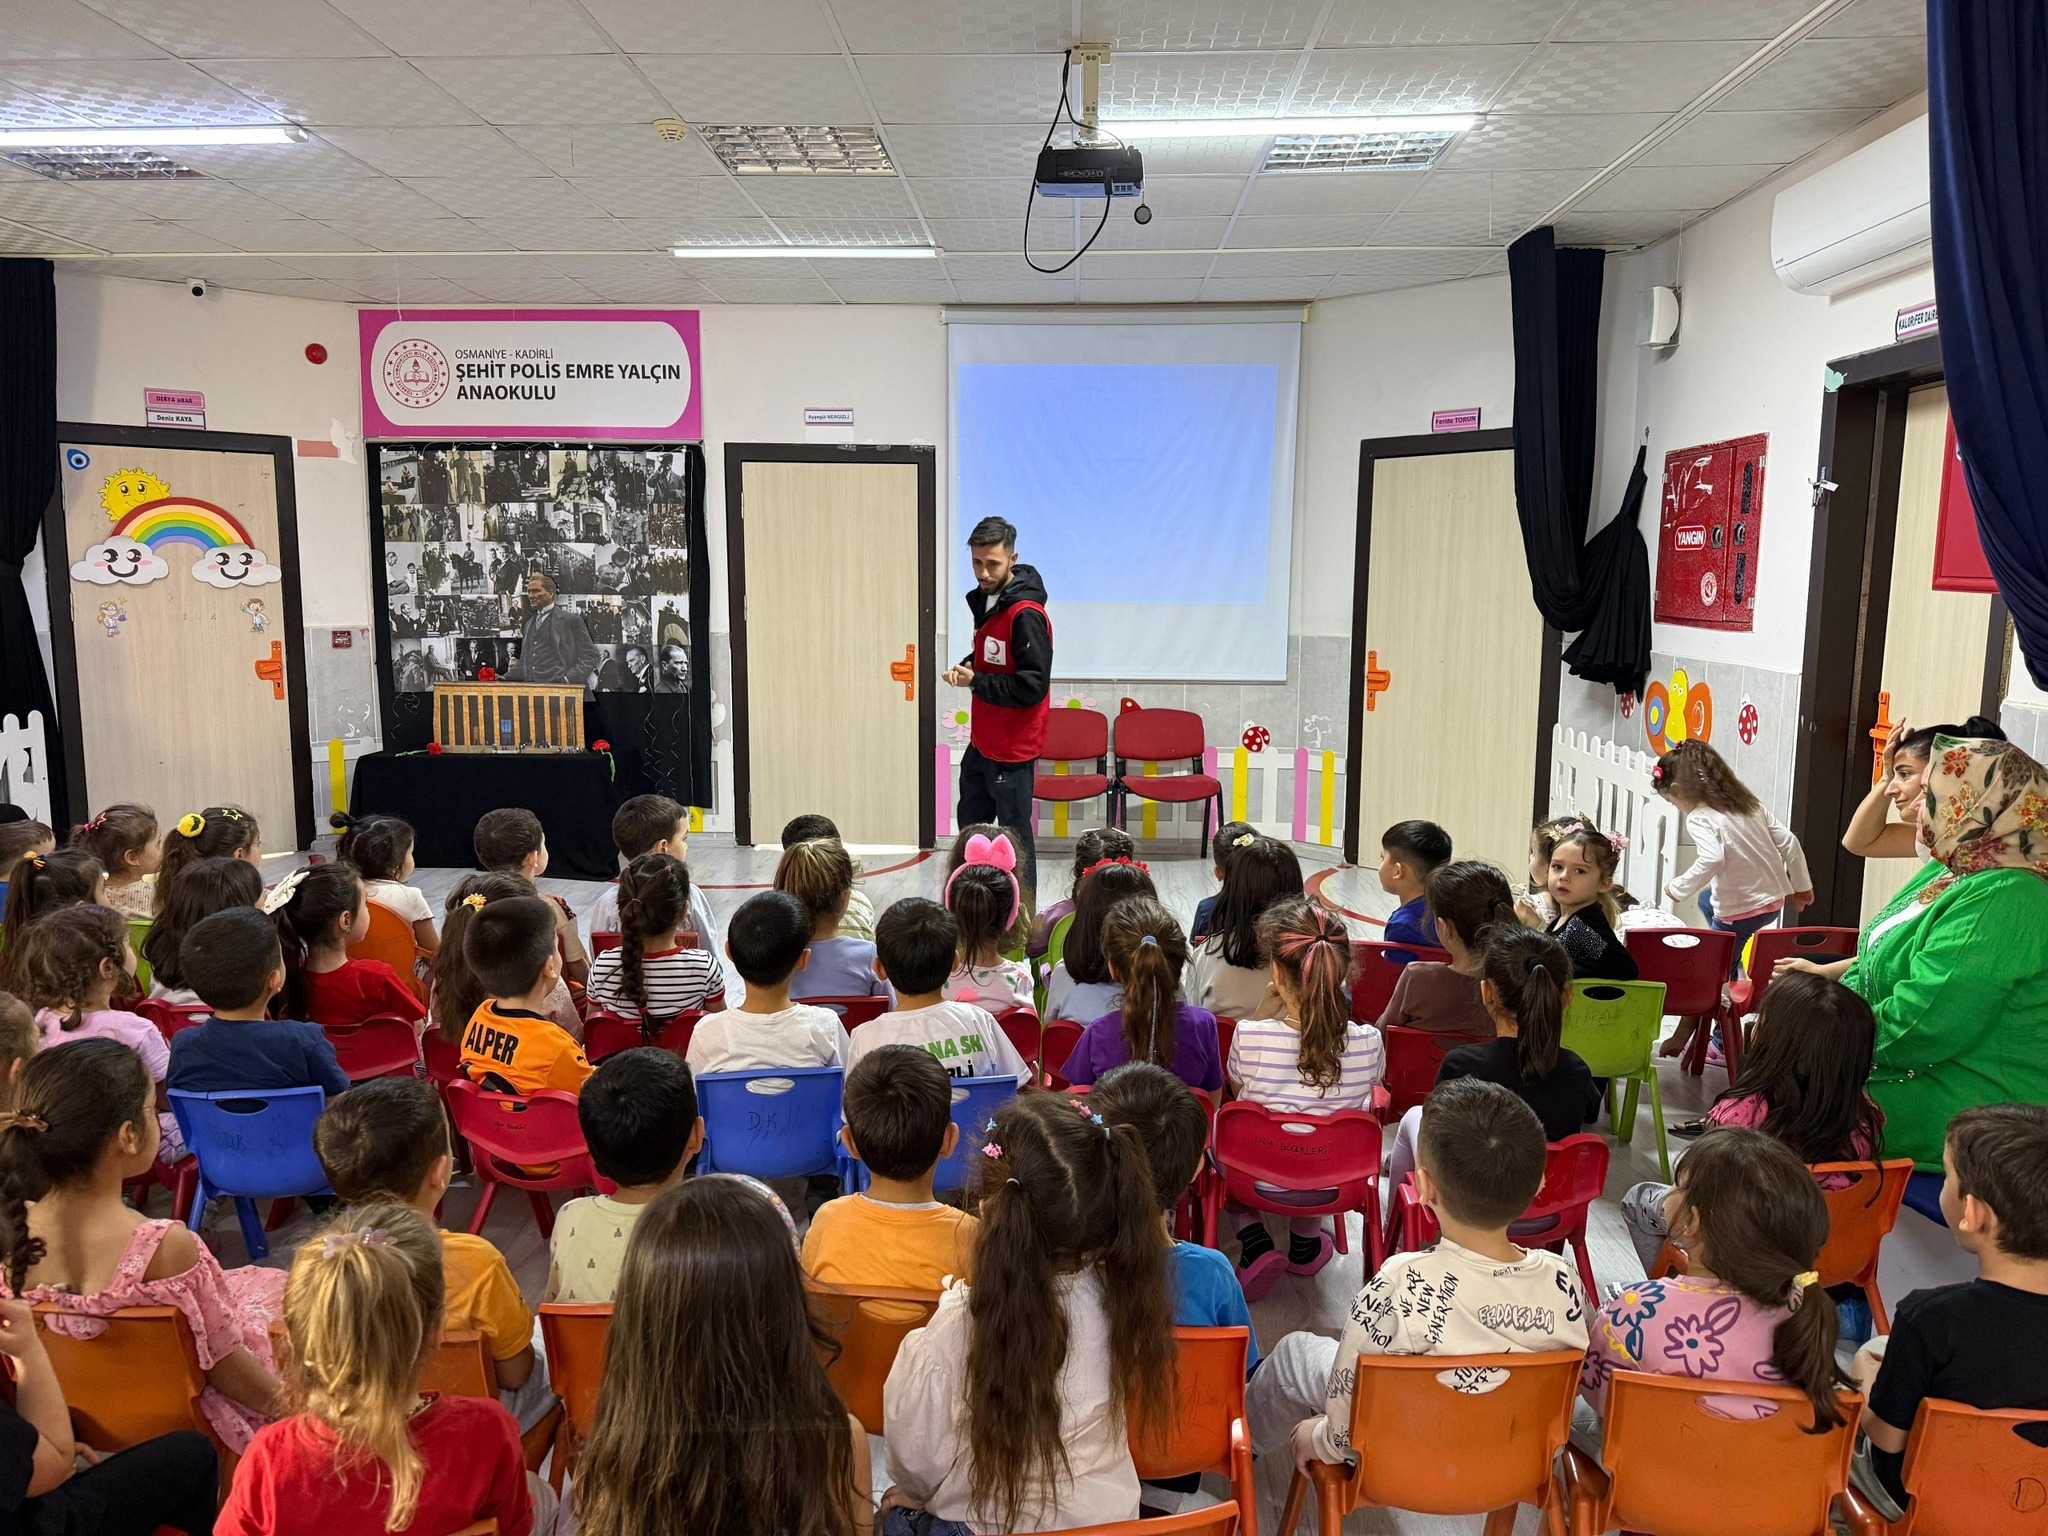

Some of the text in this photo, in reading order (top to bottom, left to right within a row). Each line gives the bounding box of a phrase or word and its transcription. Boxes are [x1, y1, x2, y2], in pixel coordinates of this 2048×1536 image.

[455, 348, 507, 359] OSMANİYE
[515, 348, 554, 359] KADİRLİ
[456, 360, 681, 384] ŞEHİT POLİS EMRE YALÇIN
[456, 384, 557, 401] ANAOKULU
[175, 415, 193, 423] KAYA
[1677, 530, 1705, 546] YANGIN
[465, 1021, 519, 1066] ALPER
[1492, 1265, 1513, 1278] RIGHT
[1416, 1282, 1436, 1319] NEW
[1424, 1270, 1460, 1345] GENERATION
[1477, 1303, 1555, 1336] BROOKLYN
